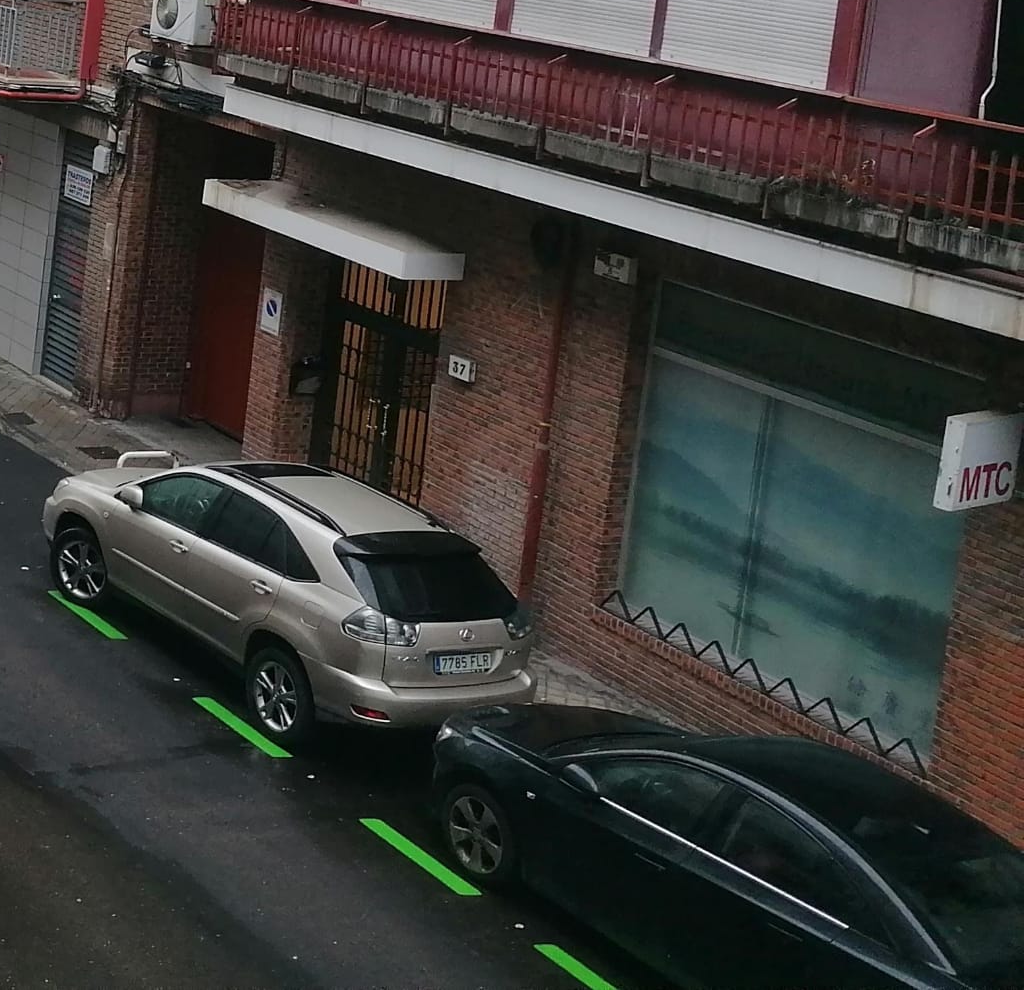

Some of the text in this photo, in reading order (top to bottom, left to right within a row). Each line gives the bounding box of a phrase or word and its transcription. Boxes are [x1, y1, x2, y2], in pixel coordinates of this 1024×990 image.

[452, 361, 466, 376] 37
[959, 461, 1012, 503] MTC
[442, 653, 490, 671] 7785 FLR
